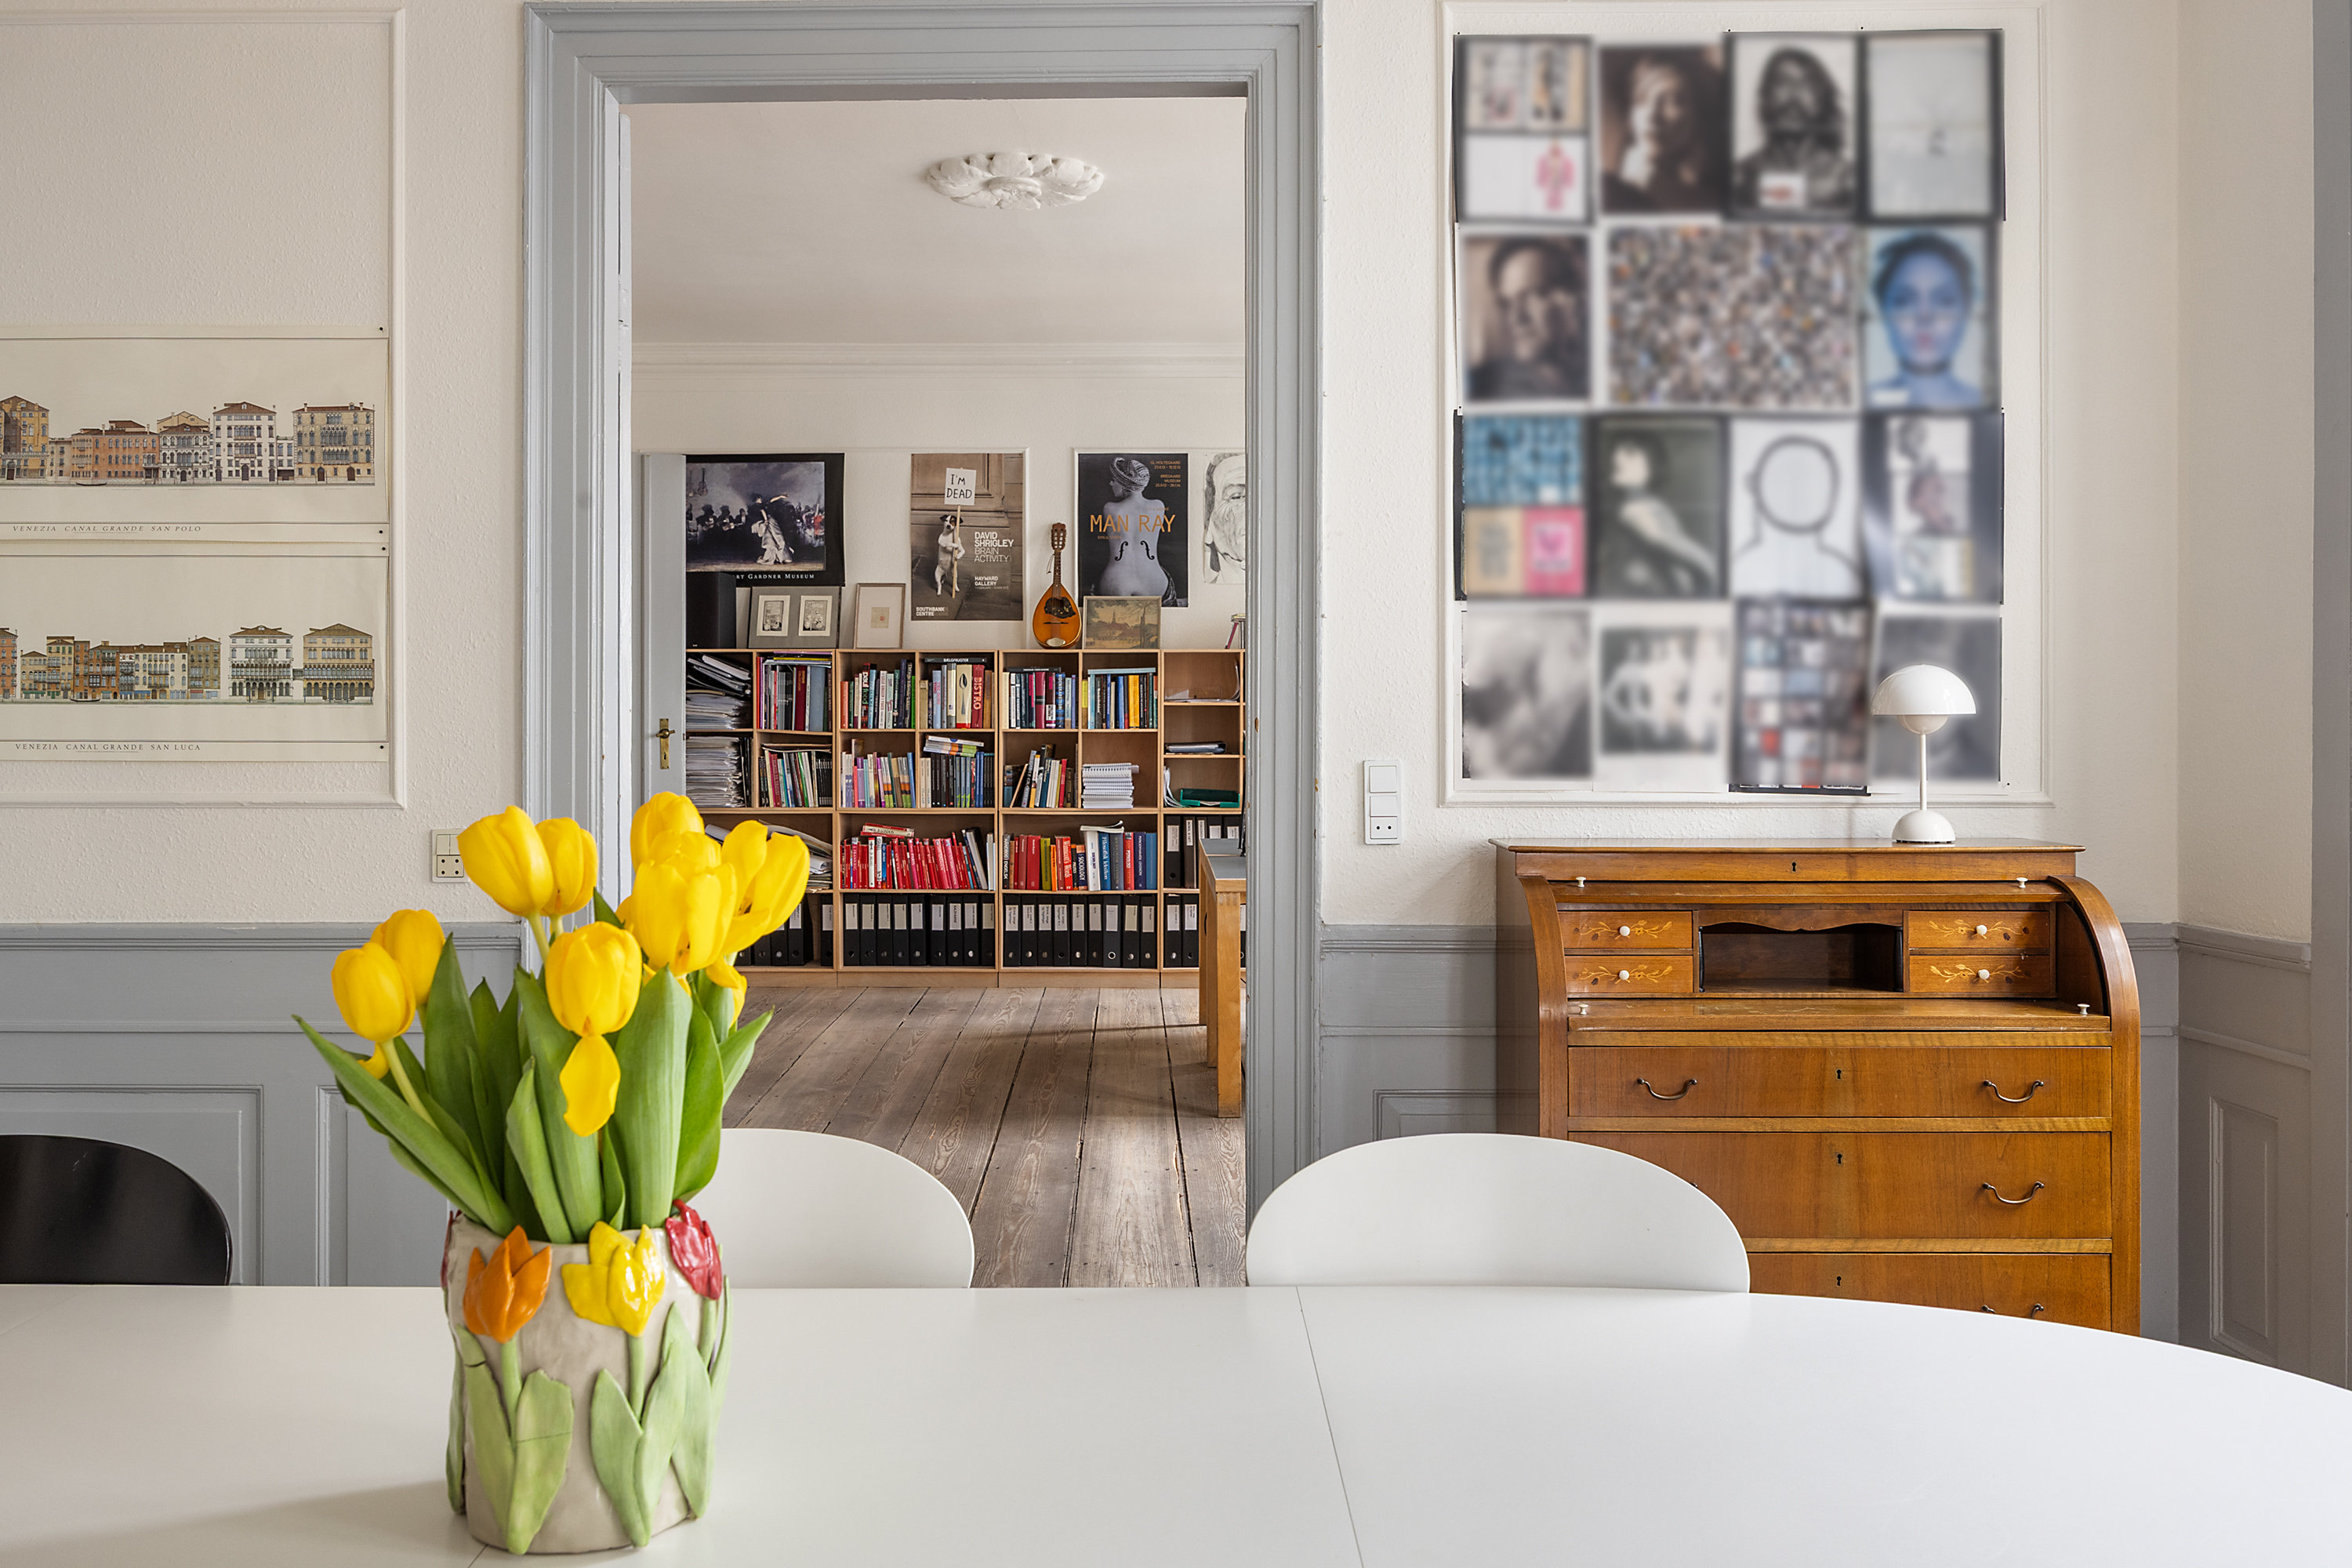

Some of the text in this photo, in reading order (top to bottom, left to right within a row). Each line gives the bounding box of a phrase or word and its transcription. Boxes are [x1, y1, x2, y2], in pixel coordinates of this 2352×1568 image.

[950, 474, 966, 485] I'M
[946, 488, 972, 499] DEAD
[1090, 514, 1176, 532] MAN RAY
[974, 539, 1014, 547] SHRIGLEY
[974, 554, 1010, 563] ACTIVITY
[974, 677, 982, 710] BISTRO
